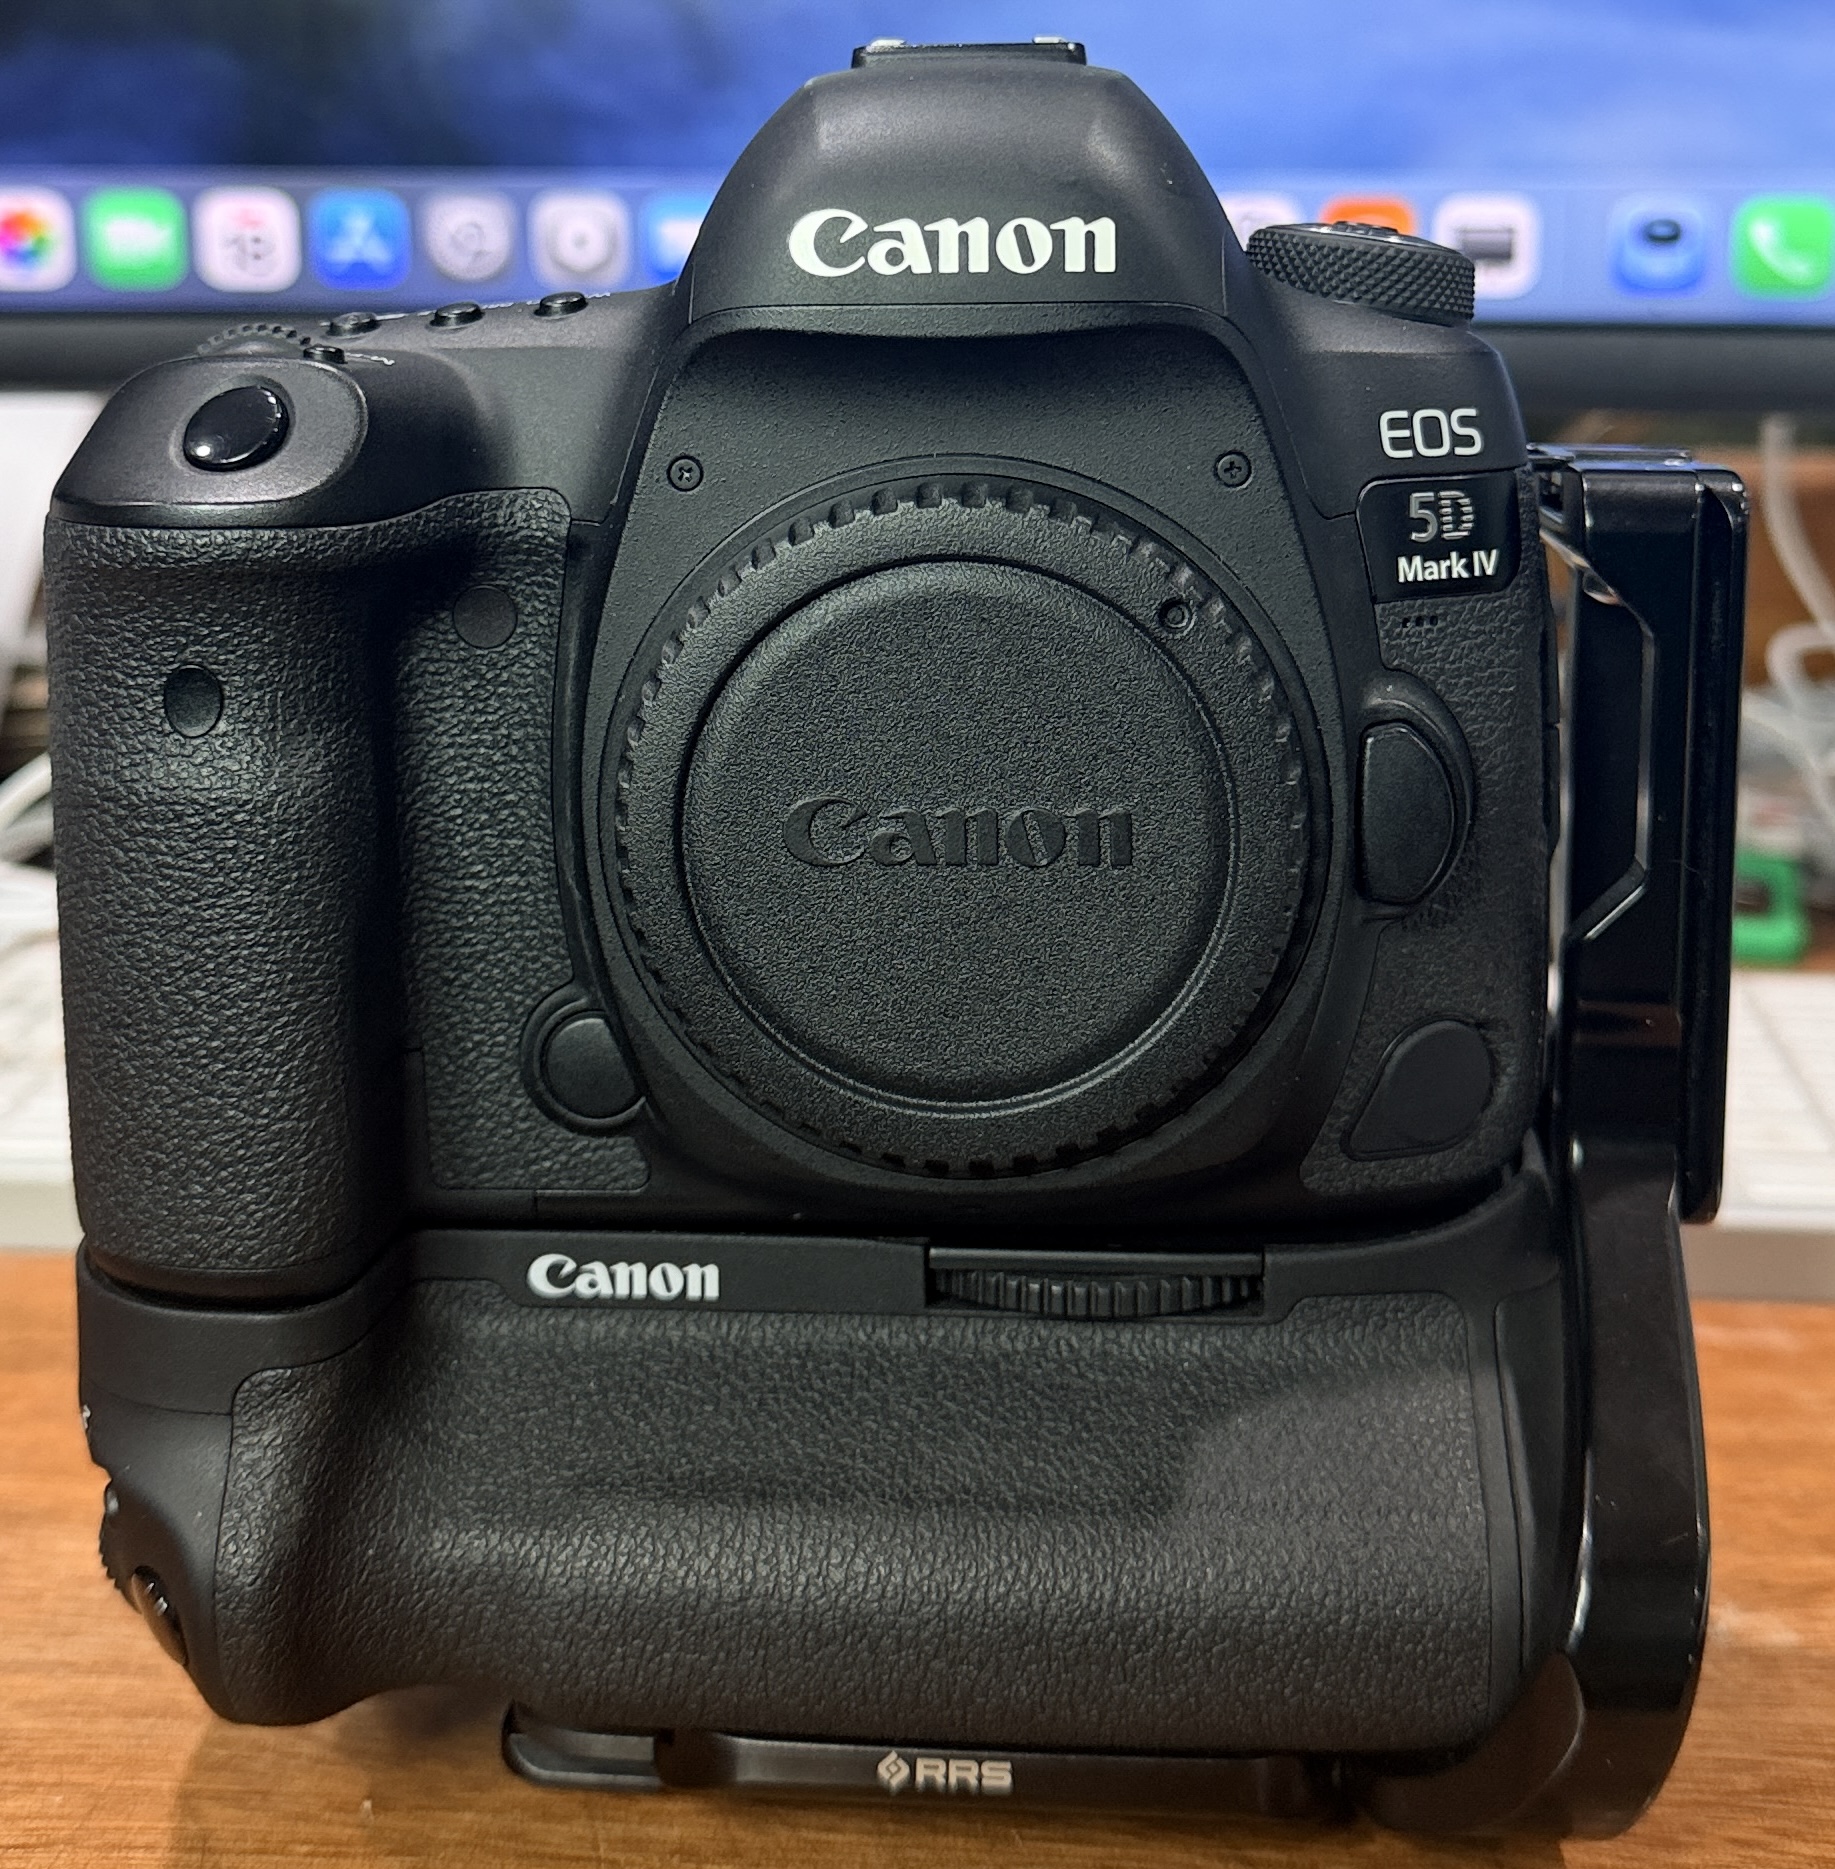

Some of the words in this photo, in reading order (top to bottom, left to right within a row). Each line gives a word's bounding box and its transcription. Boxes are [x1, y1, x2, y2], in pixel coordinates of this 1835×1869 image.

[788, 208, 1117, 277] Canon
[1379, 408, 1484, 458] EOS
[1409, 488, 1474, 542] 5D
[1397, 551, 1470, 583] Mark
[1472, 549, 1498, 577] IV
[783, 796, 1133, 867] Canon
[527, 1253, 720, 1301] Canon
[915, 1757, 1014, 1796] RRS
